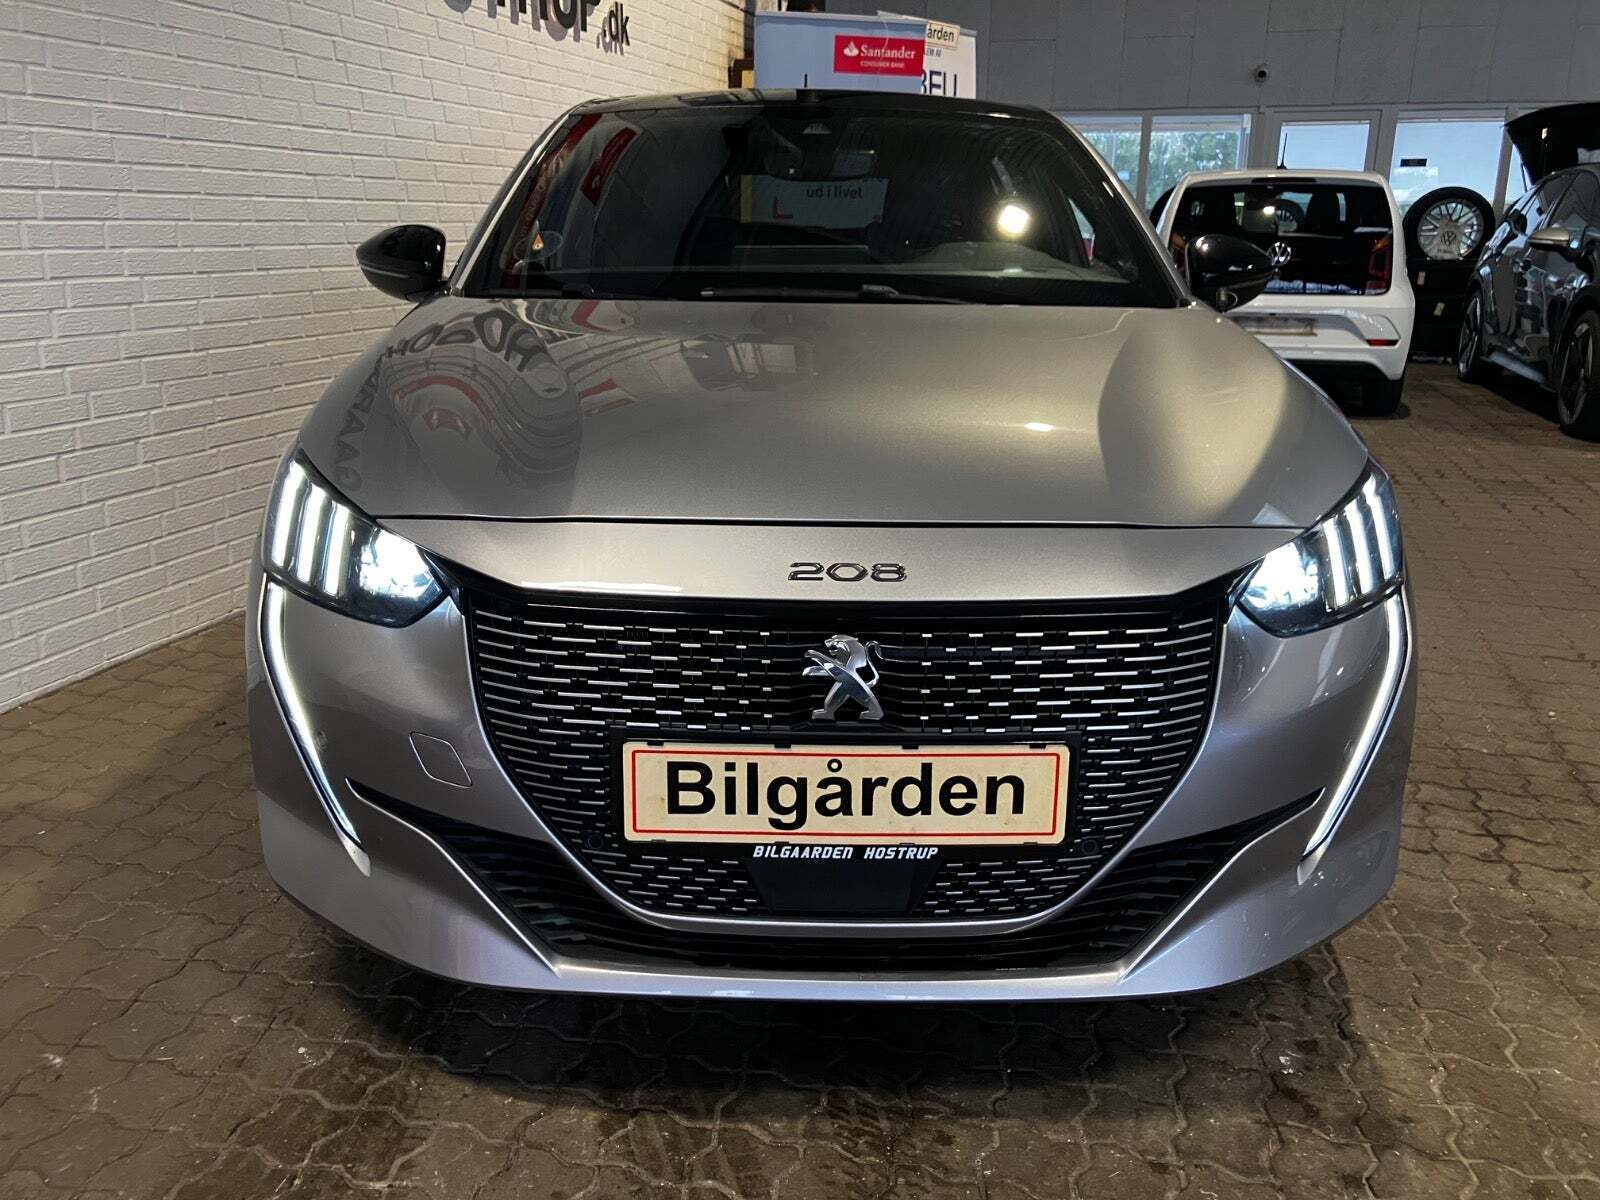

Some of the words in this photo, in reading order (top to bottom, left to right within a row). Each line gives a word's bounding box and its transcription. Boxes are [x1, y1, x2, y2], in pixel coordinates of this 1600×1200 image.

[860, 44, 916, 60] Santander
[807, 185, 823, 199] ud
[834, 185, 863, 200] livet
[788, 562, 907, 582] 208
[666, 758, 1025, 830] Bilgården
[753, 845, 853, 859] BILGAARDEN
[863, 846, 938, 860] HOSTRUP
